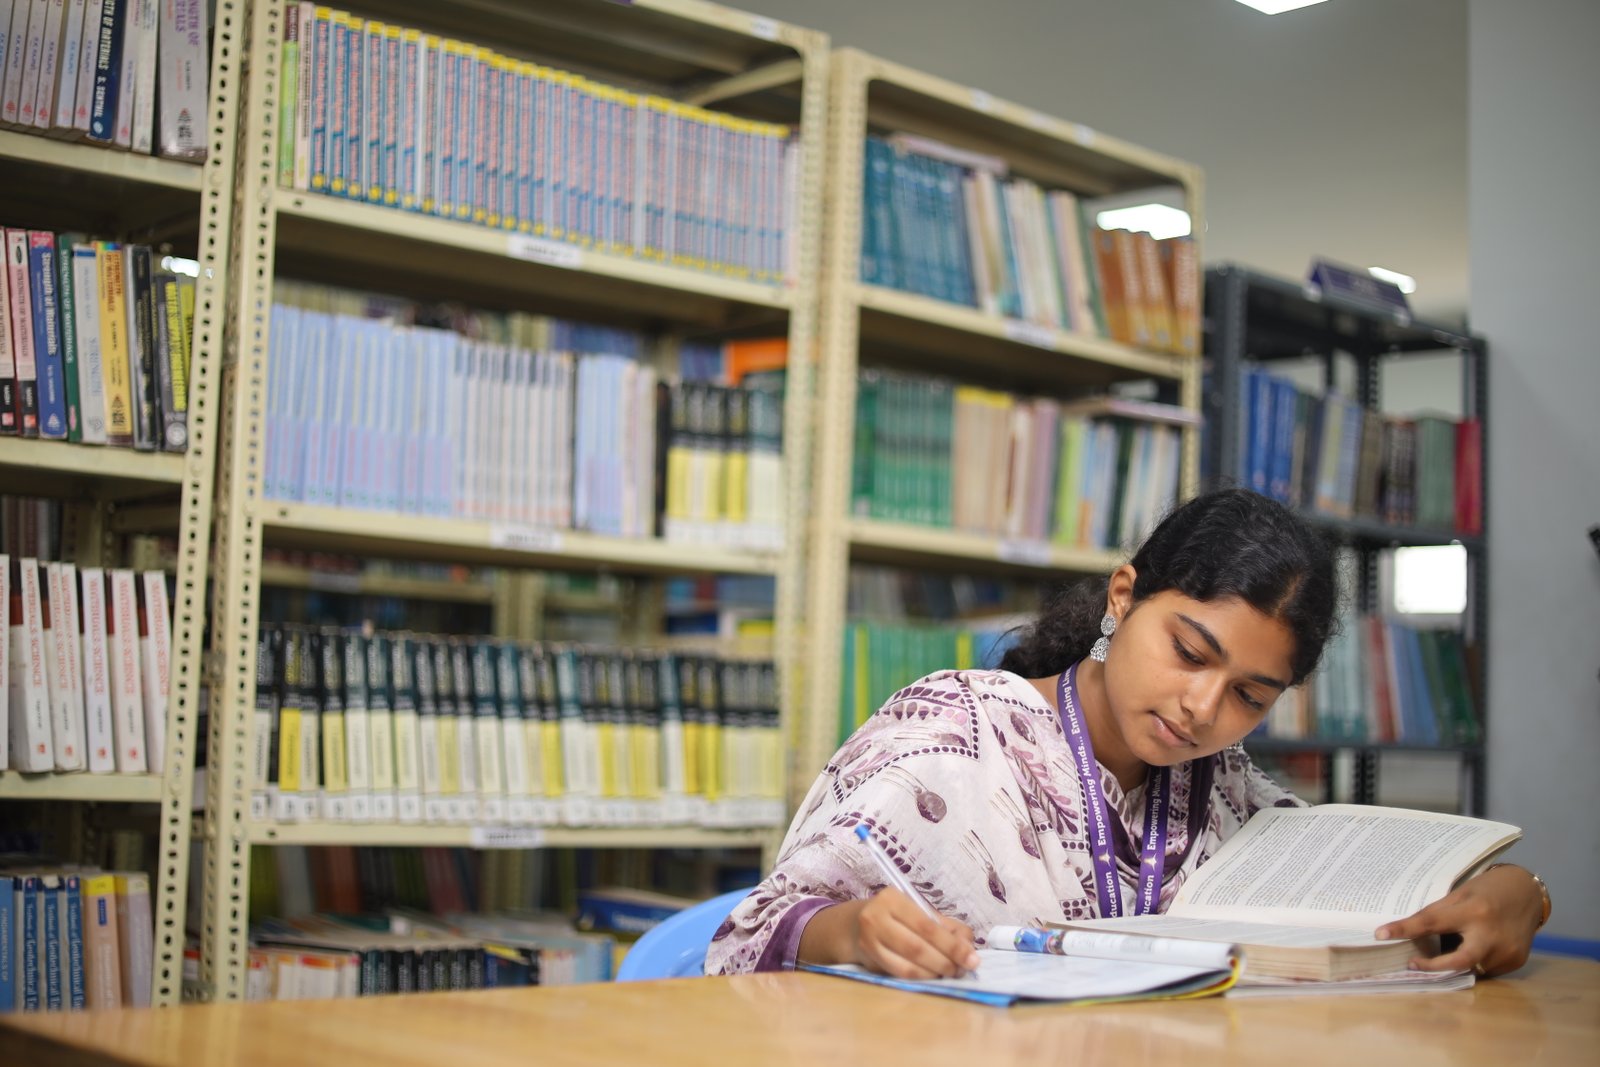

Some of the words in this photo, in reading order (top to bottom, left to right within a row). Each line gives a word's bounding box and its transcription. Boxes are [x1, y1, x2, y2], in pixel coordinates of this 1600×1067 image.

[98, 27, 112, 71] MATERIALS
[42, 252, 55, 295] Strength
[61, 250, 70, 297] STRENGTH
[46, 307, 57, 355] Materials
[27, 568, 38, 634] MATERIALS
[89, 578, 101, 643] MATERIALS
[119, 579, 131, 643] MATERIALS
[152, 580, 165, 646] MATERIALS
[31, 639, 42, 687] SCIENCE
[57, 642, 68, 689] SCIENCE
[93, 646, 104, 695] SCIENCE
[123, 646, 135, 695] SCIENCE
[157, 649, 169, 695] SCIENCE
[1063, 686, 1081, 735] Enriching
[1087, 779, 1107, 847] Empowering
[1147, 797, 1162, 851] Empowering
[1105, 871, 1117, 918] ducation
[1141, 874, 1154, 915] ucation
